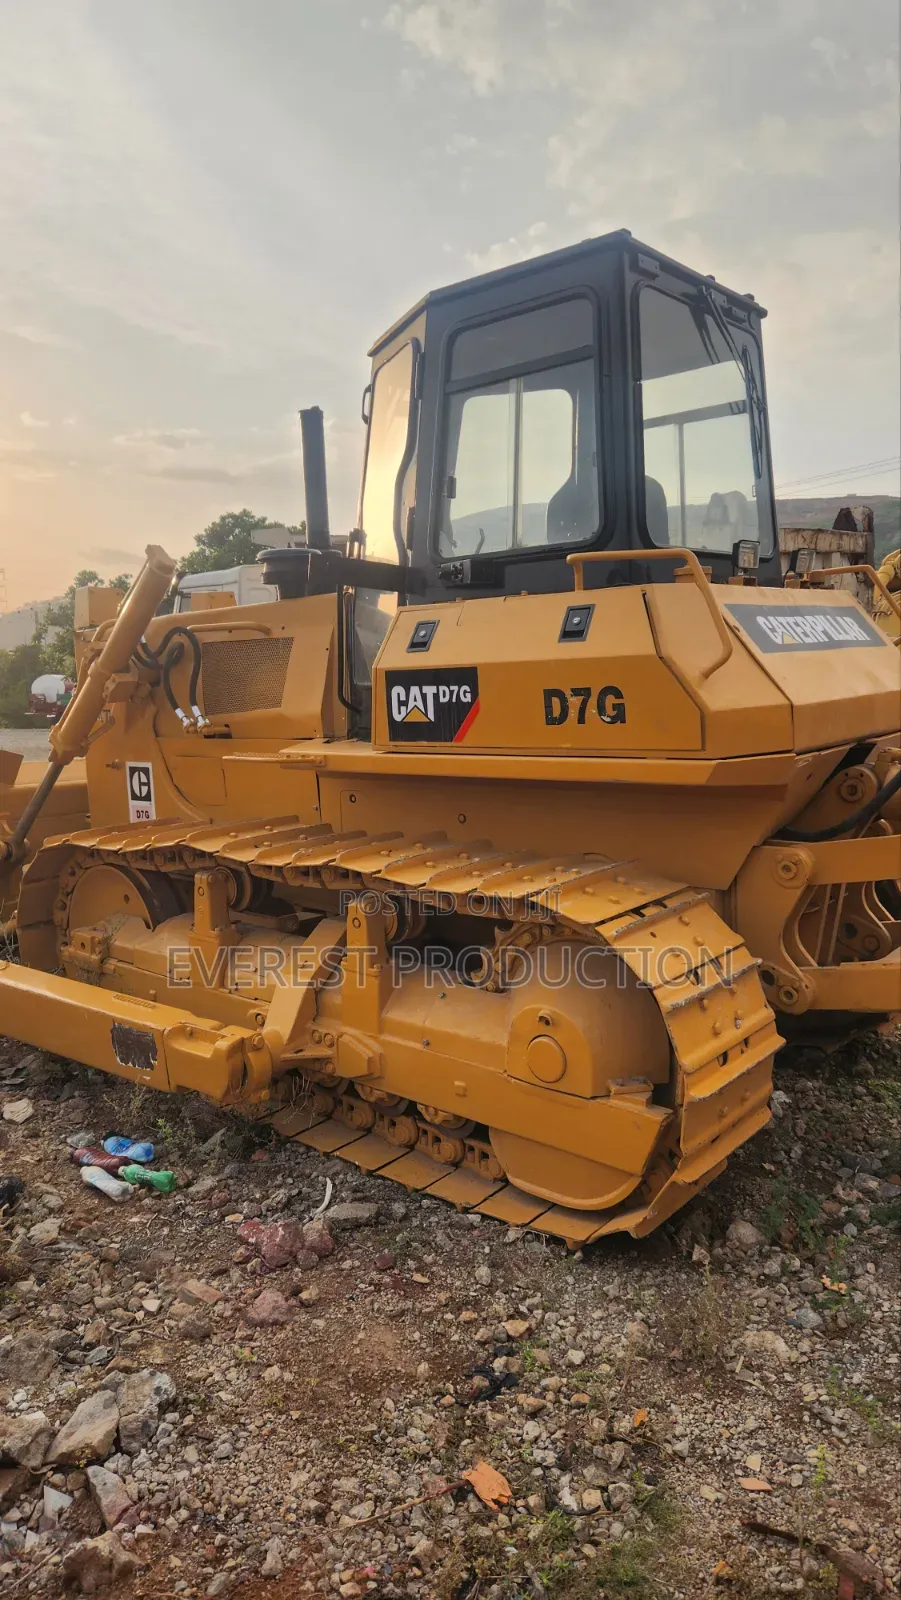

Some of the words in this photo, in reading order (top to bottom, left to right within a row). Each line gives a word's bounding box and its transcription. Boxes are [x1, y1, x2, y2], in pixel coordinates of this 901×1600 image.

[756, 615, 871, 645] CATERPILLAR
[391, 685, 435, 723] CAT
[438, 685, 472, 703] D7G
[543, 685, 626, 725] D7G
[136, 810, 150, 819] D7G
